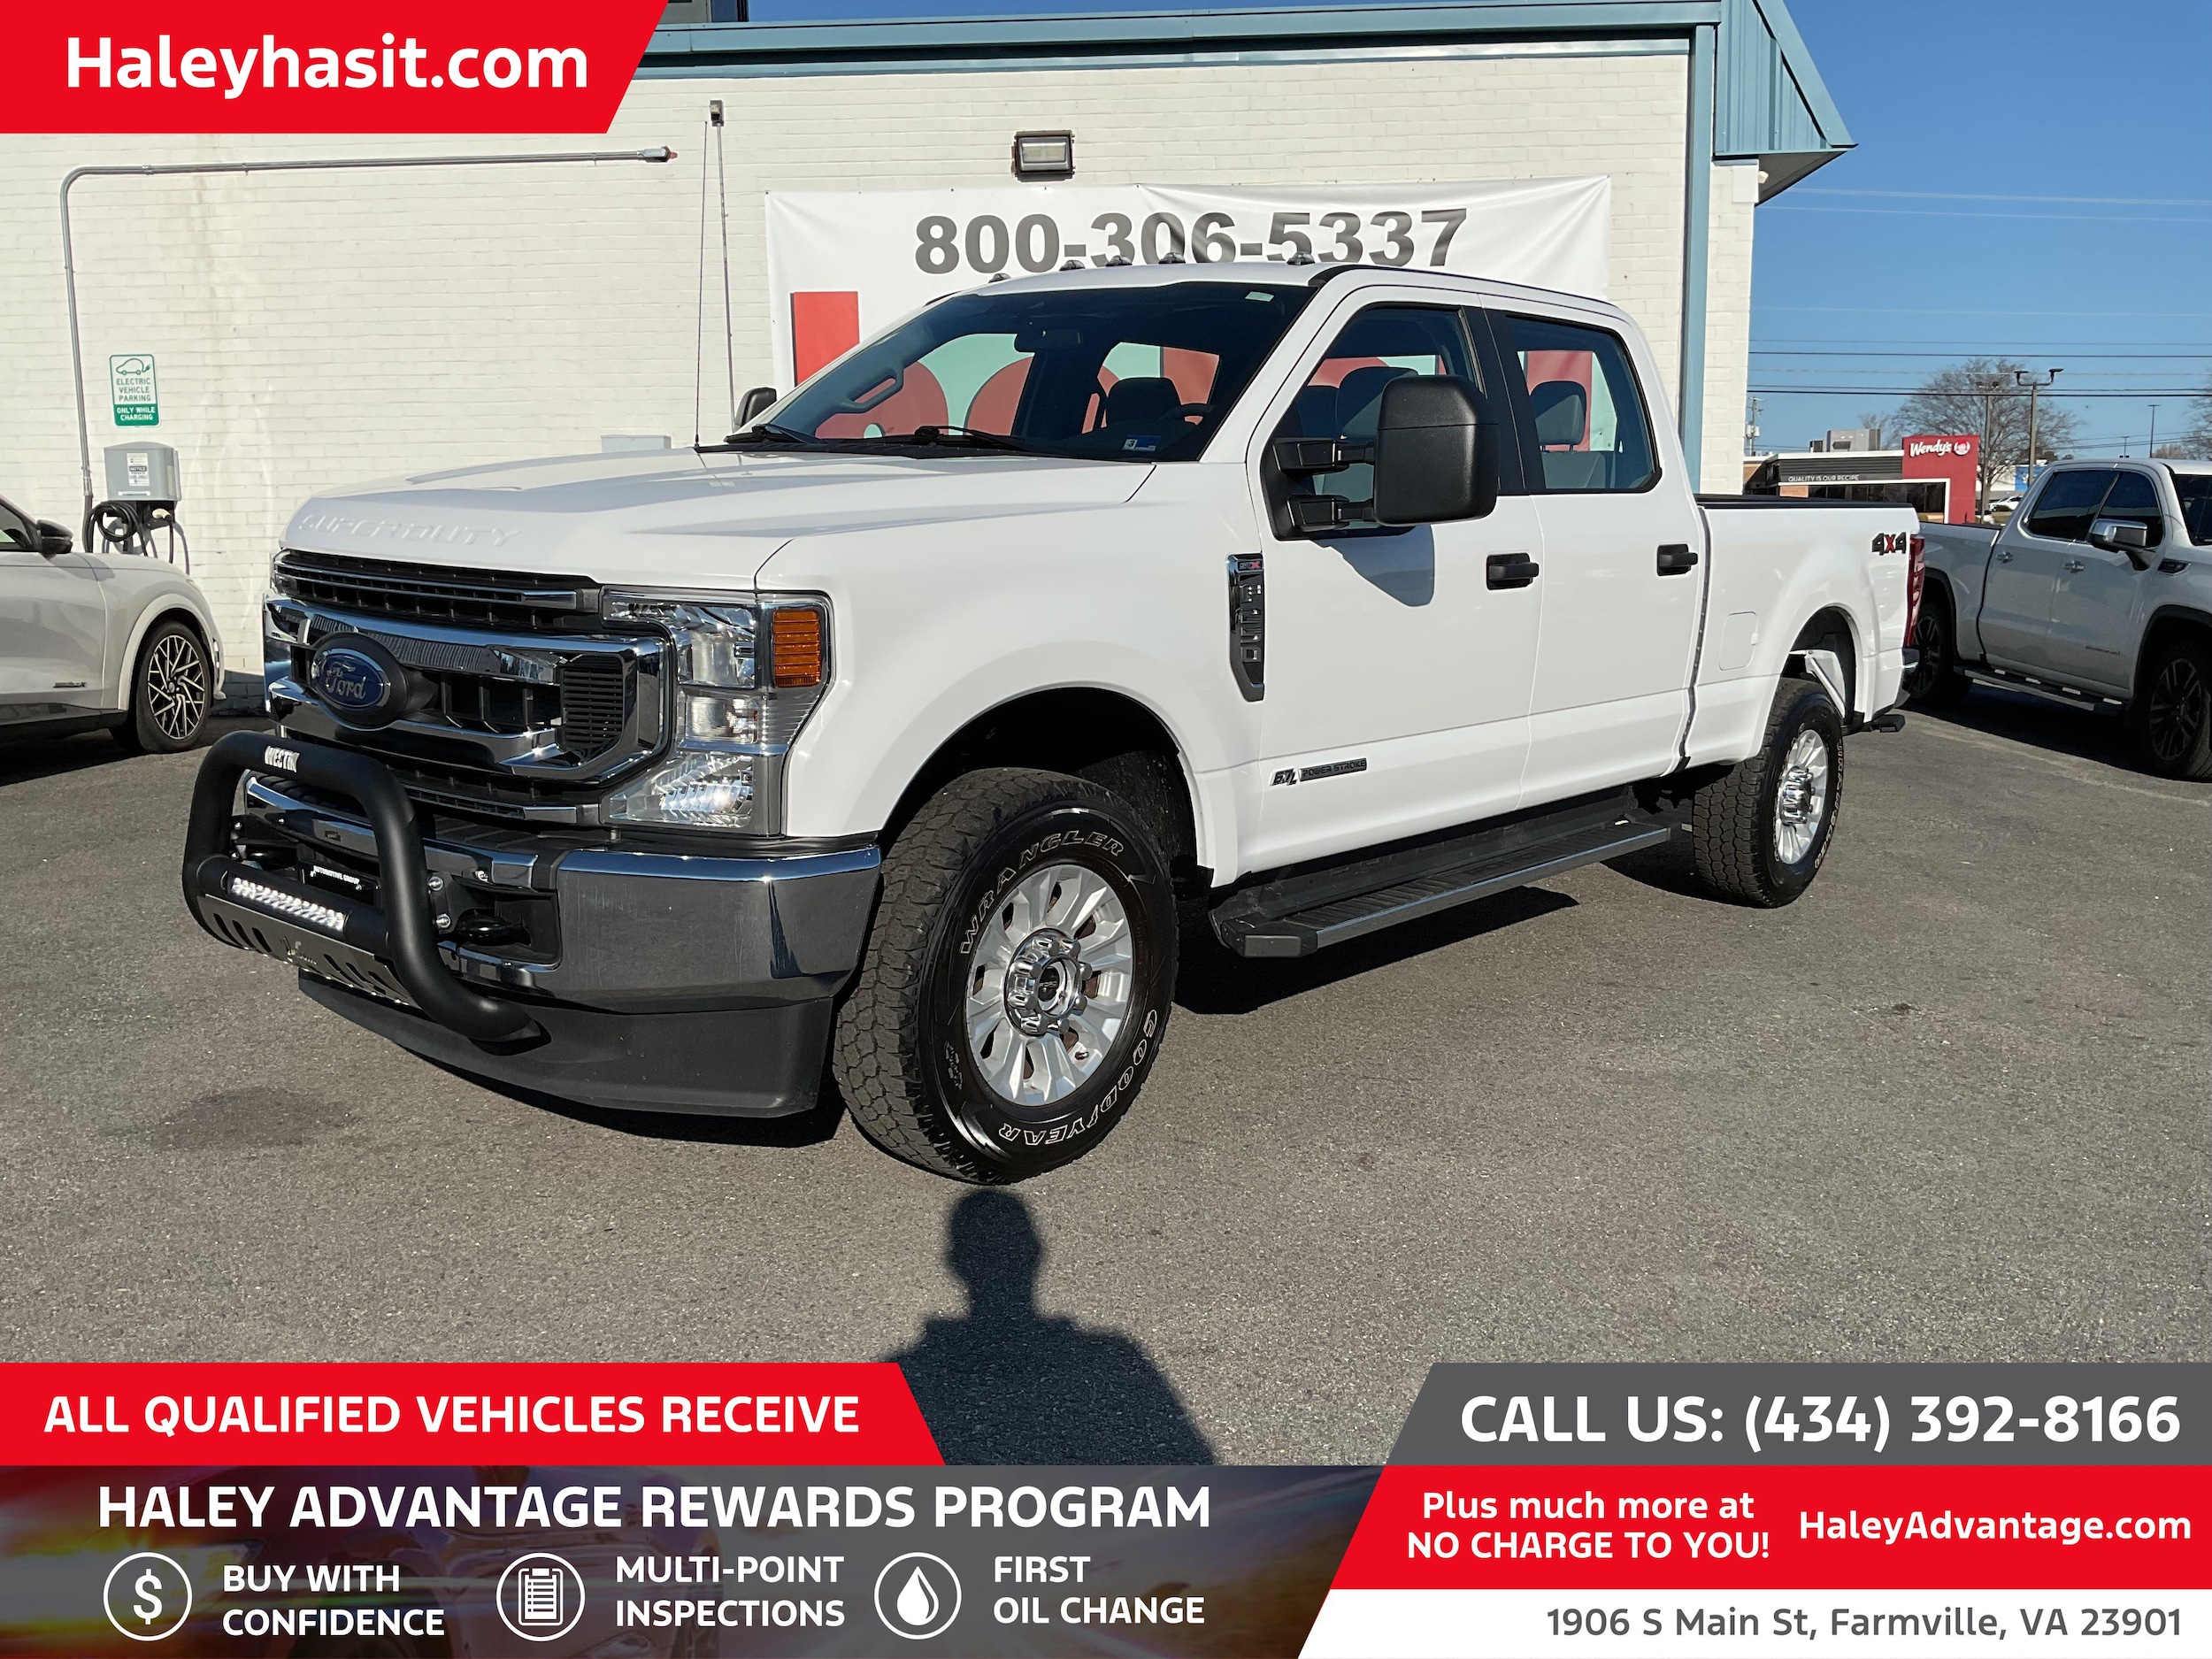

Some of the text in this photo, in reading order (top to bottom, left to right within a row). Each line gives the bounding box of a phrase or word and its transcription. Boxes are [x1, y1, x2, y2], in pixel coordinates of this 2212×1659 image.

[915, 209, 1468, 274] 800-306-5337
[1909, 439, 1953, 457] Wendy's
[325, 661, 366, 700] Ford
[265, 745, 300, 773] WESTIN
[1302, 765, 1332, 778] POWER
[1333, 759, 1365, 772] STROKE
[960, 830, 1125, 955] WRANGLER
[998, 1010, 1157, 1146] GOODYEAR
